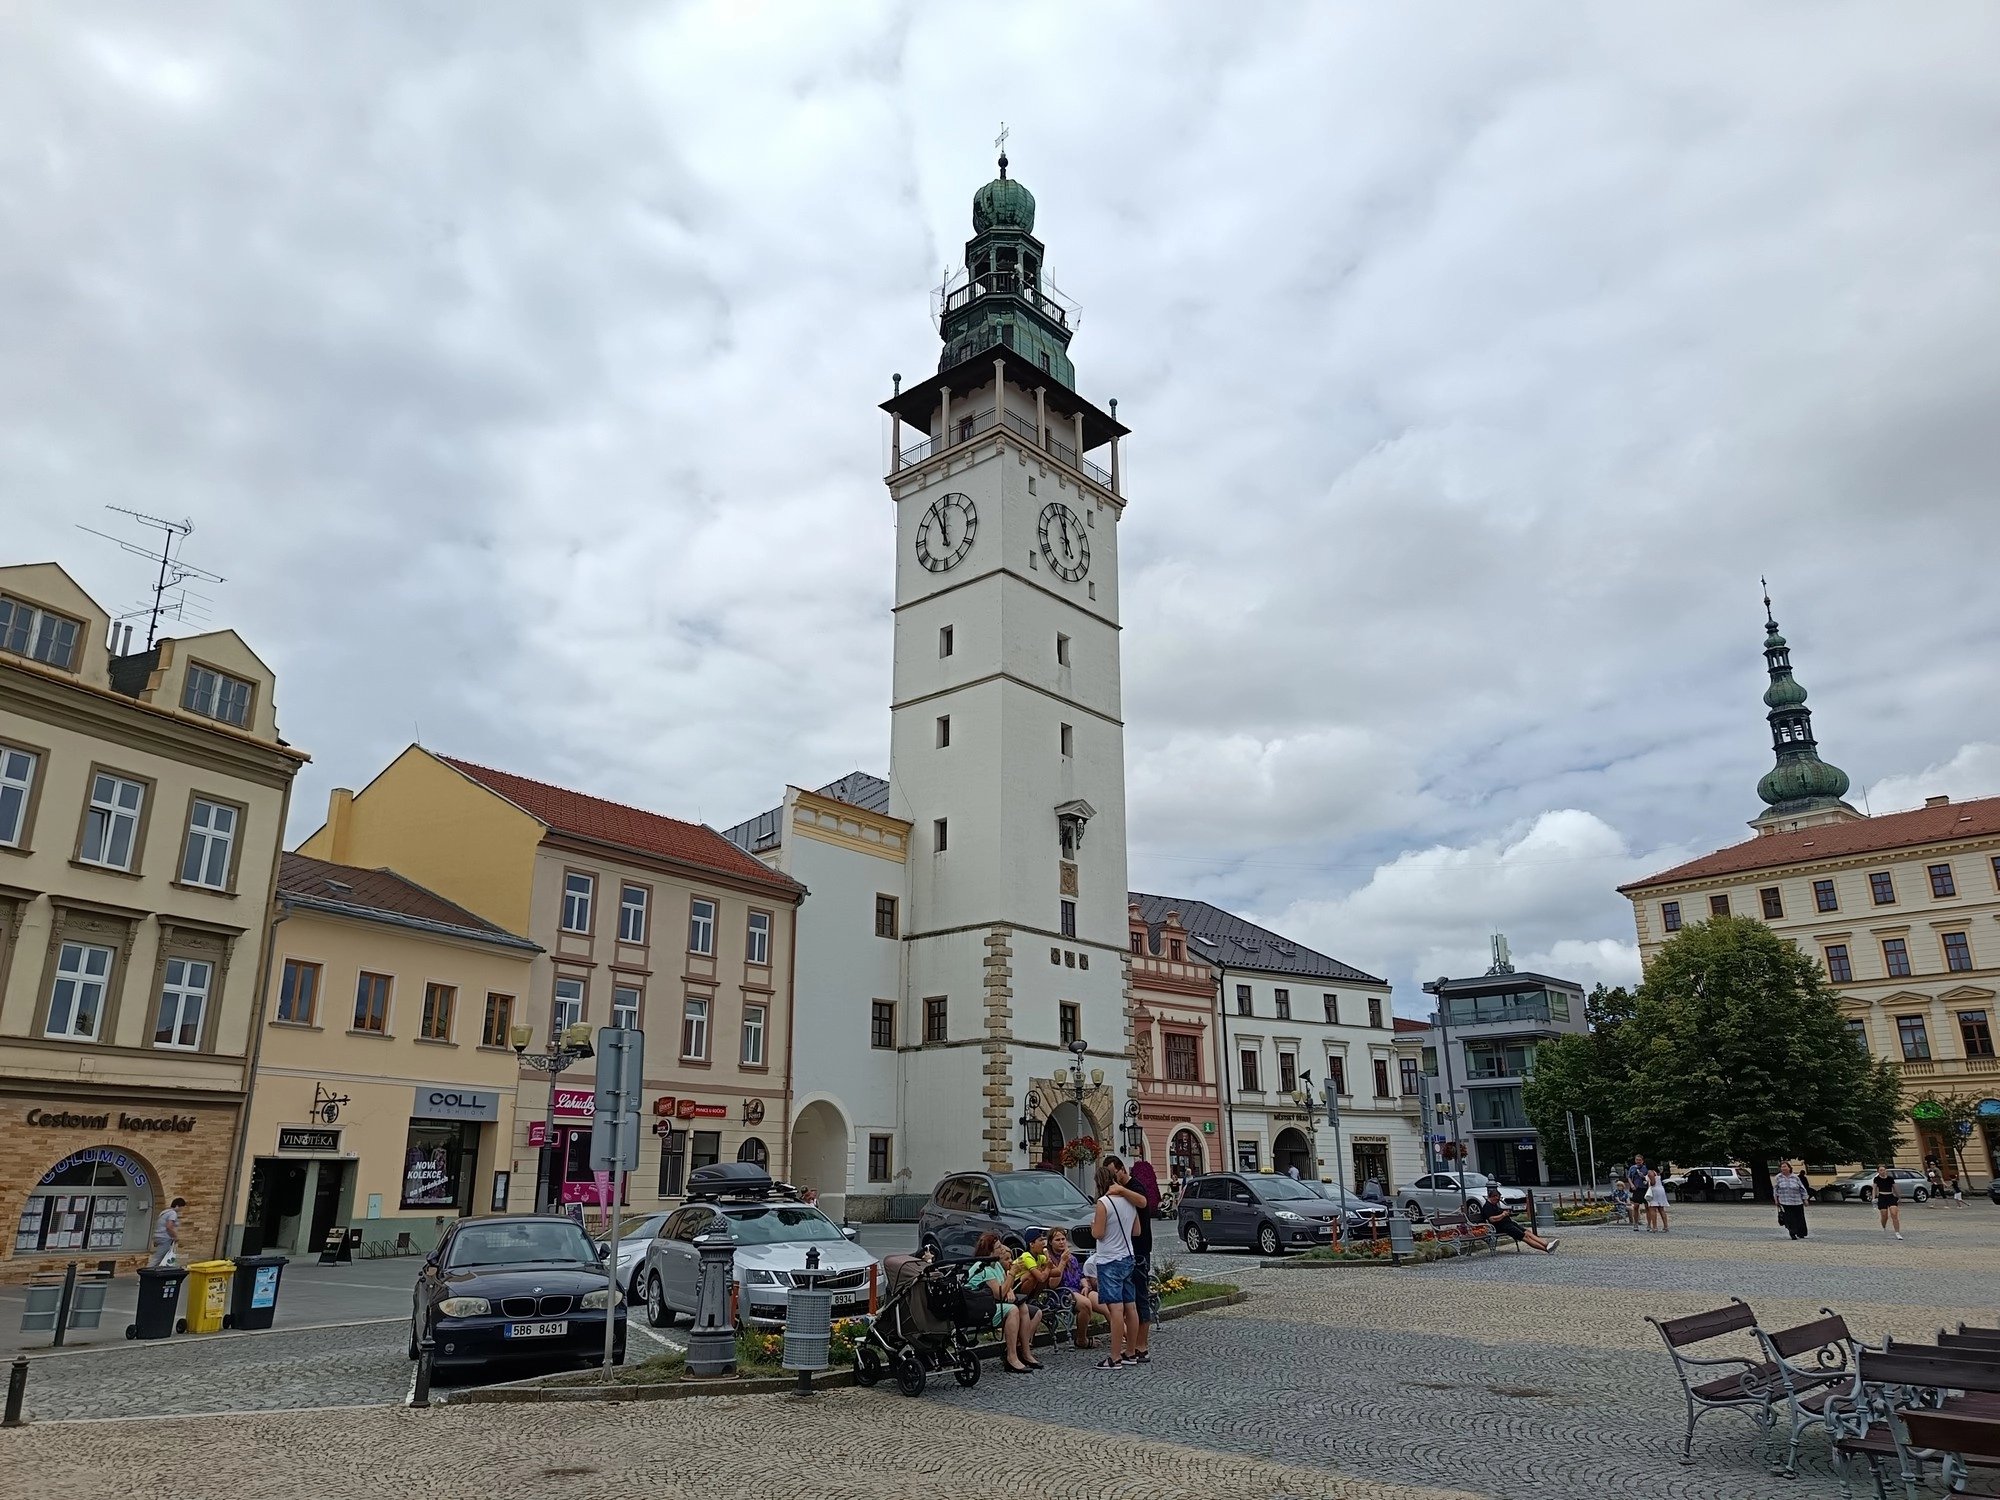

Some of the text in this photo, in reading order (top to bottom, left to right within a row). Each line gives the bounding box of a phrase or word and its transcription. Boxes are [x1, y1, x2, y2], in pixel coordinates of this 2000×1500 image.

[430, 1092, 487, 1108] COLL
[429, 1108, 484, 1116] FASHION
[27, 1108, 197, 1132] Cestovní kancelář
[283, 1133, 334, 1146] VINOTÉKA
[42, 1149, 147, 1188] COLUMBUS
[416, 1160, 437, 1170] NOVÁ
[407, 1170, 442, 1180] KOLEKCE
[834, 1295, 852, 1304] 8934
[514, 1324, 563, 1336] 5B6 8491
